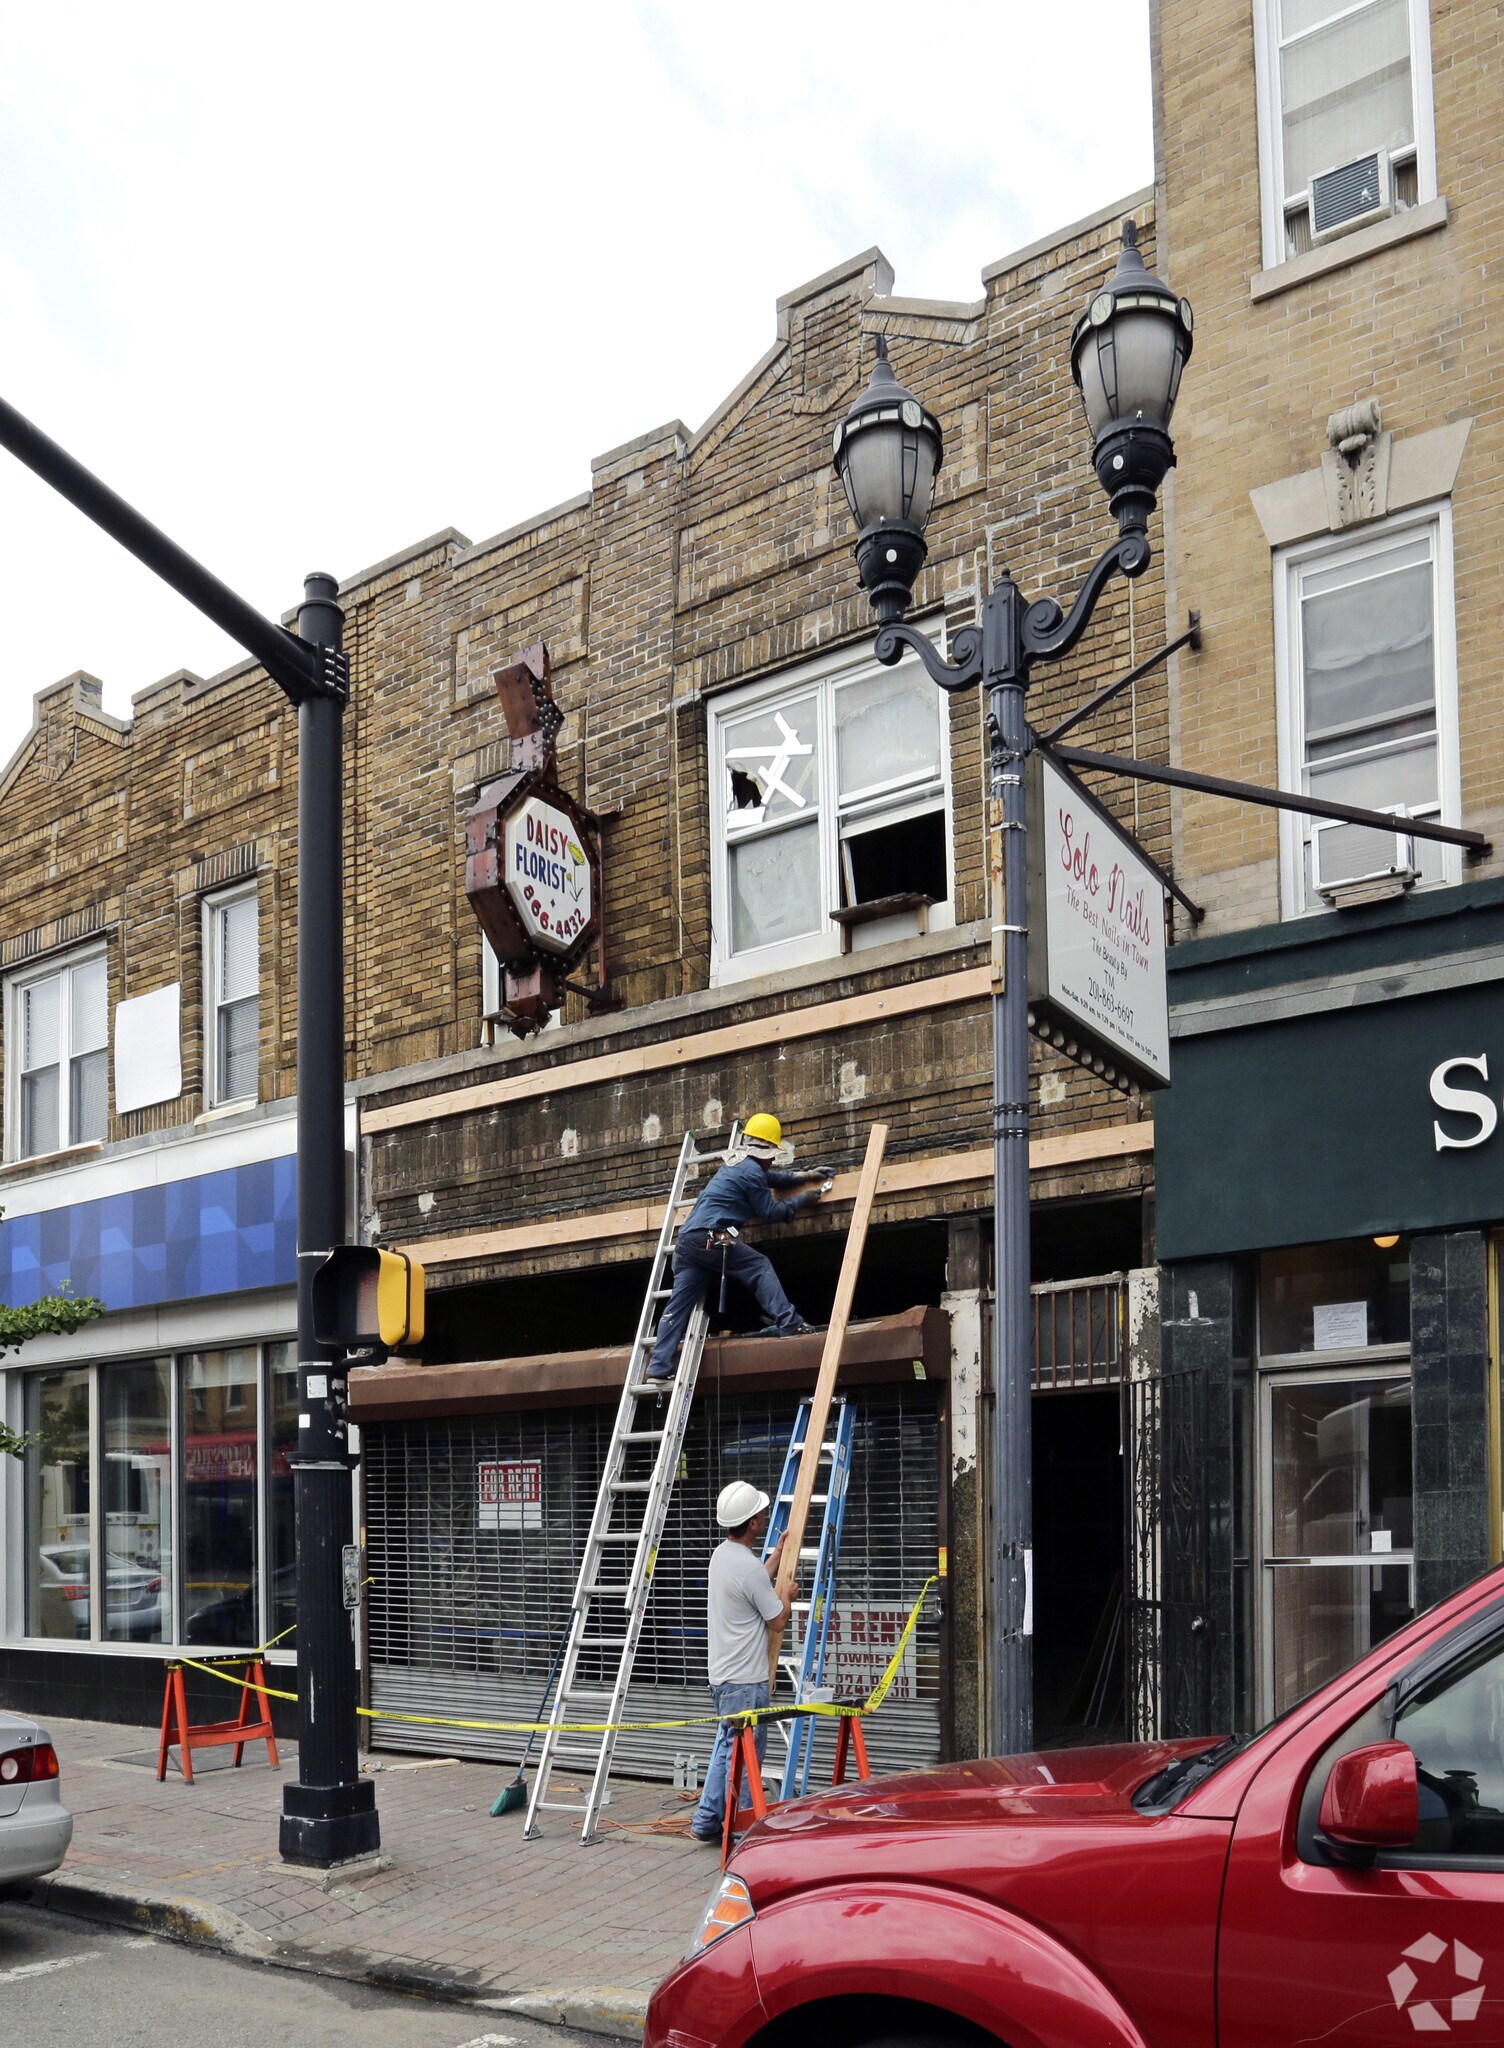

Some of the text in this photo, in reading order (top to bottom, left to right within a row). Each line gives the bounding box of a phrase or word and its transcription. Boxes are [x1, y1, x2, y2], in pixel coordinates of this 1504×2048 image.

[527, 813, 568, 860] DAISY
[516, 842, 567, 894] FLORIST
[1059, 808, 1150, 946] Solo Nails
[1066, 884, 1149, 972] The Best Nails in Town
[1092, 936, 1128, 981] The Beauty By
[1104, 969, 1115, 990] TM
[1088, 976, 1134, 1028] 201-863-6697
[1429, 1053, 1504, 1152] S
[483, 1467, 537, 1501] FOR RENT
